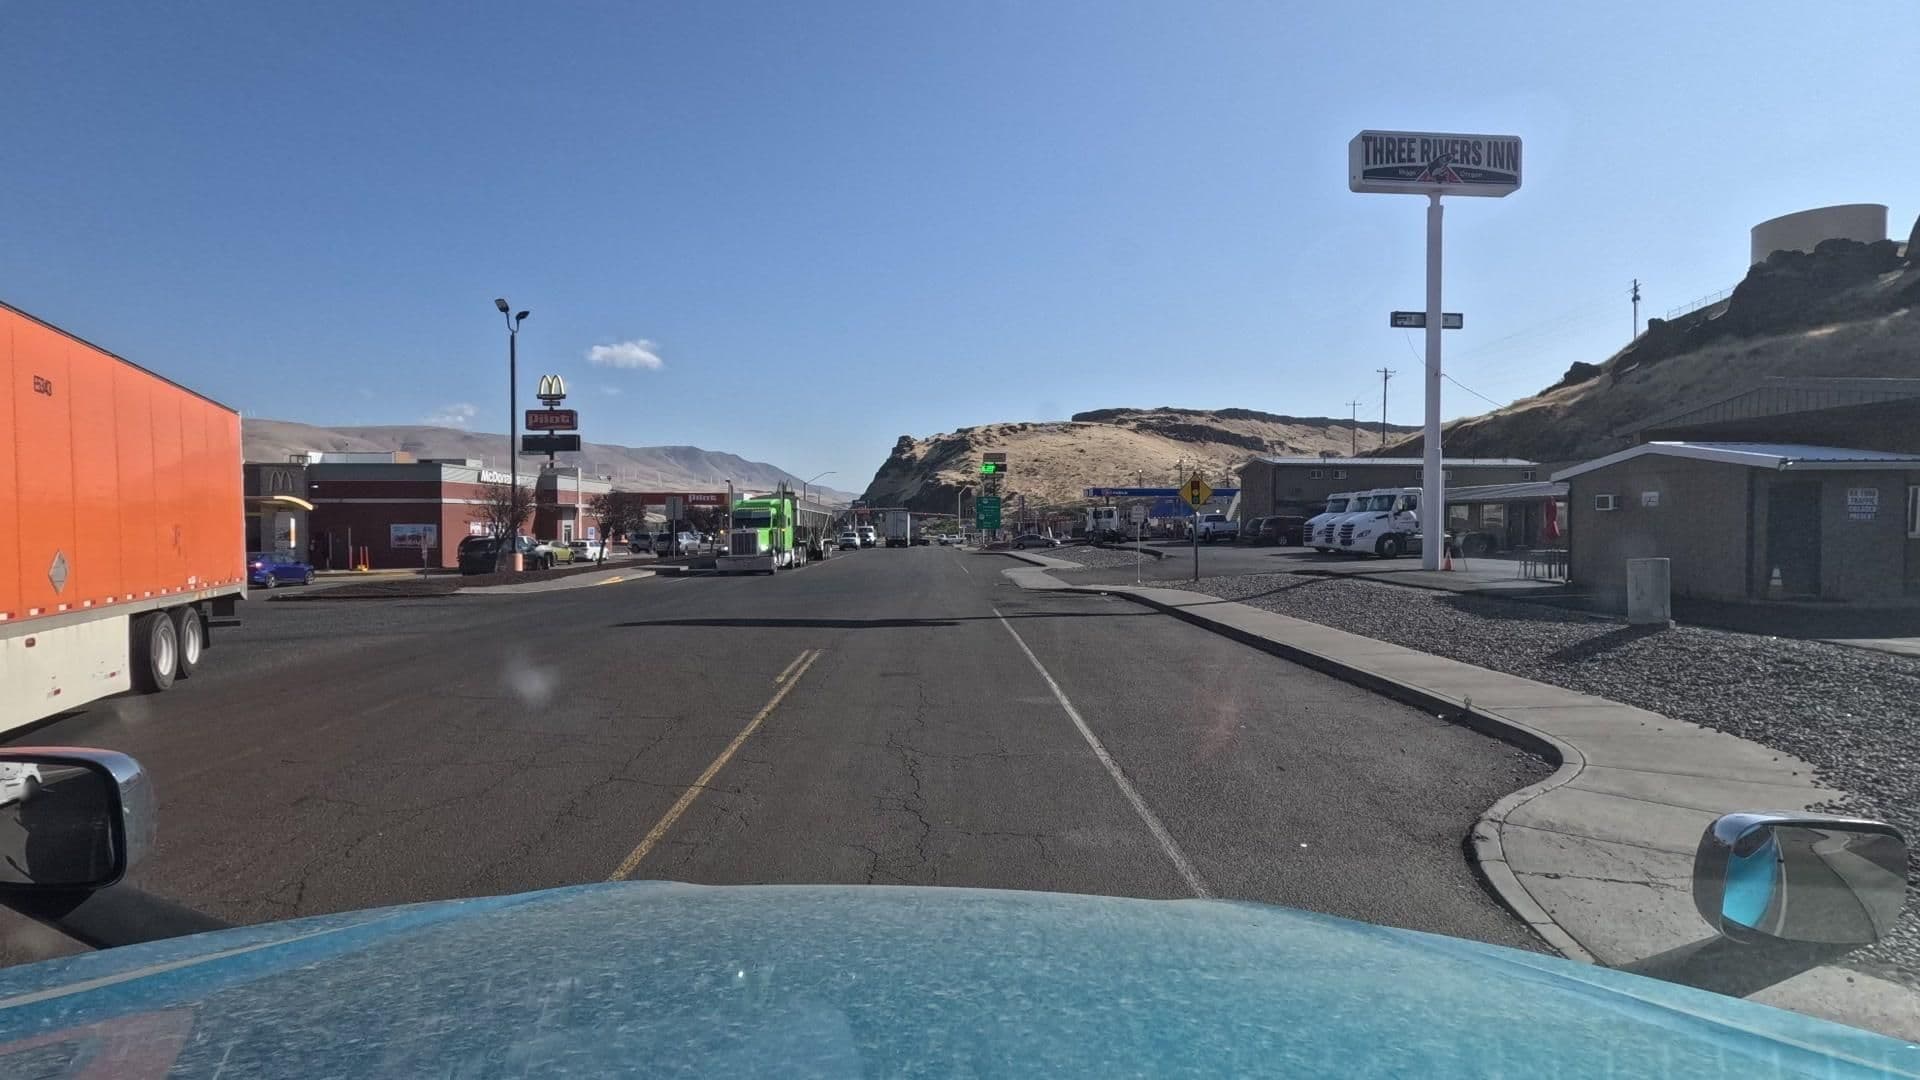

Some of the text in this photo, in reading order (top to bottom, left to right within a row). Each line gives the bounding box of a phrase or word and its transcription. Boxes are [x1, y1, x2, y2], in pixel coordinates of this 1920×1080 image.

[1362, 135, 1519, 172] THREE RIVERS INN
